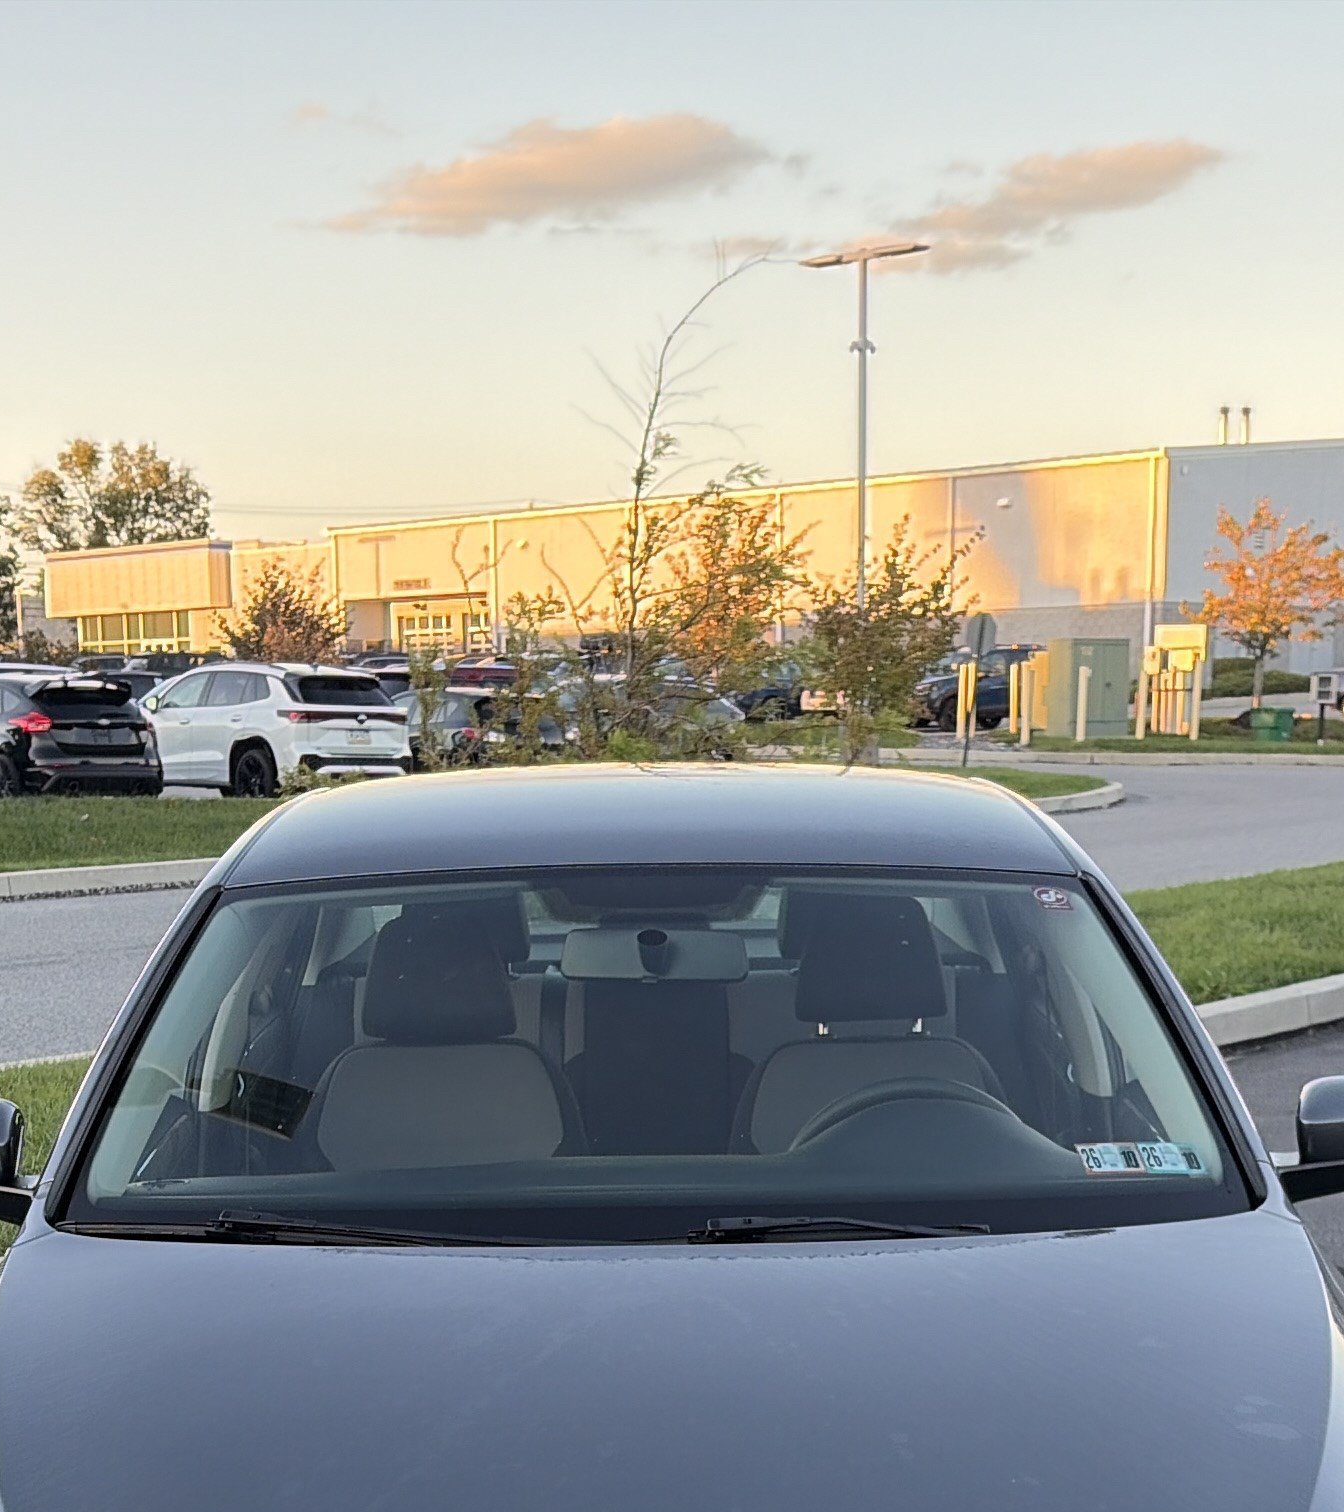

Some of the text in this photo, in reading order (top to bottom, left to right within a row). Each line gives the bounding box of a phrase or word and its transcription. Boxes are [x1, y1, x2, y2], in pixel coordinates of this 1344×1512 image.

[1081, 1147, 1140, 1169] 26 10
[1142, 1146, 1163, 1168] 26
